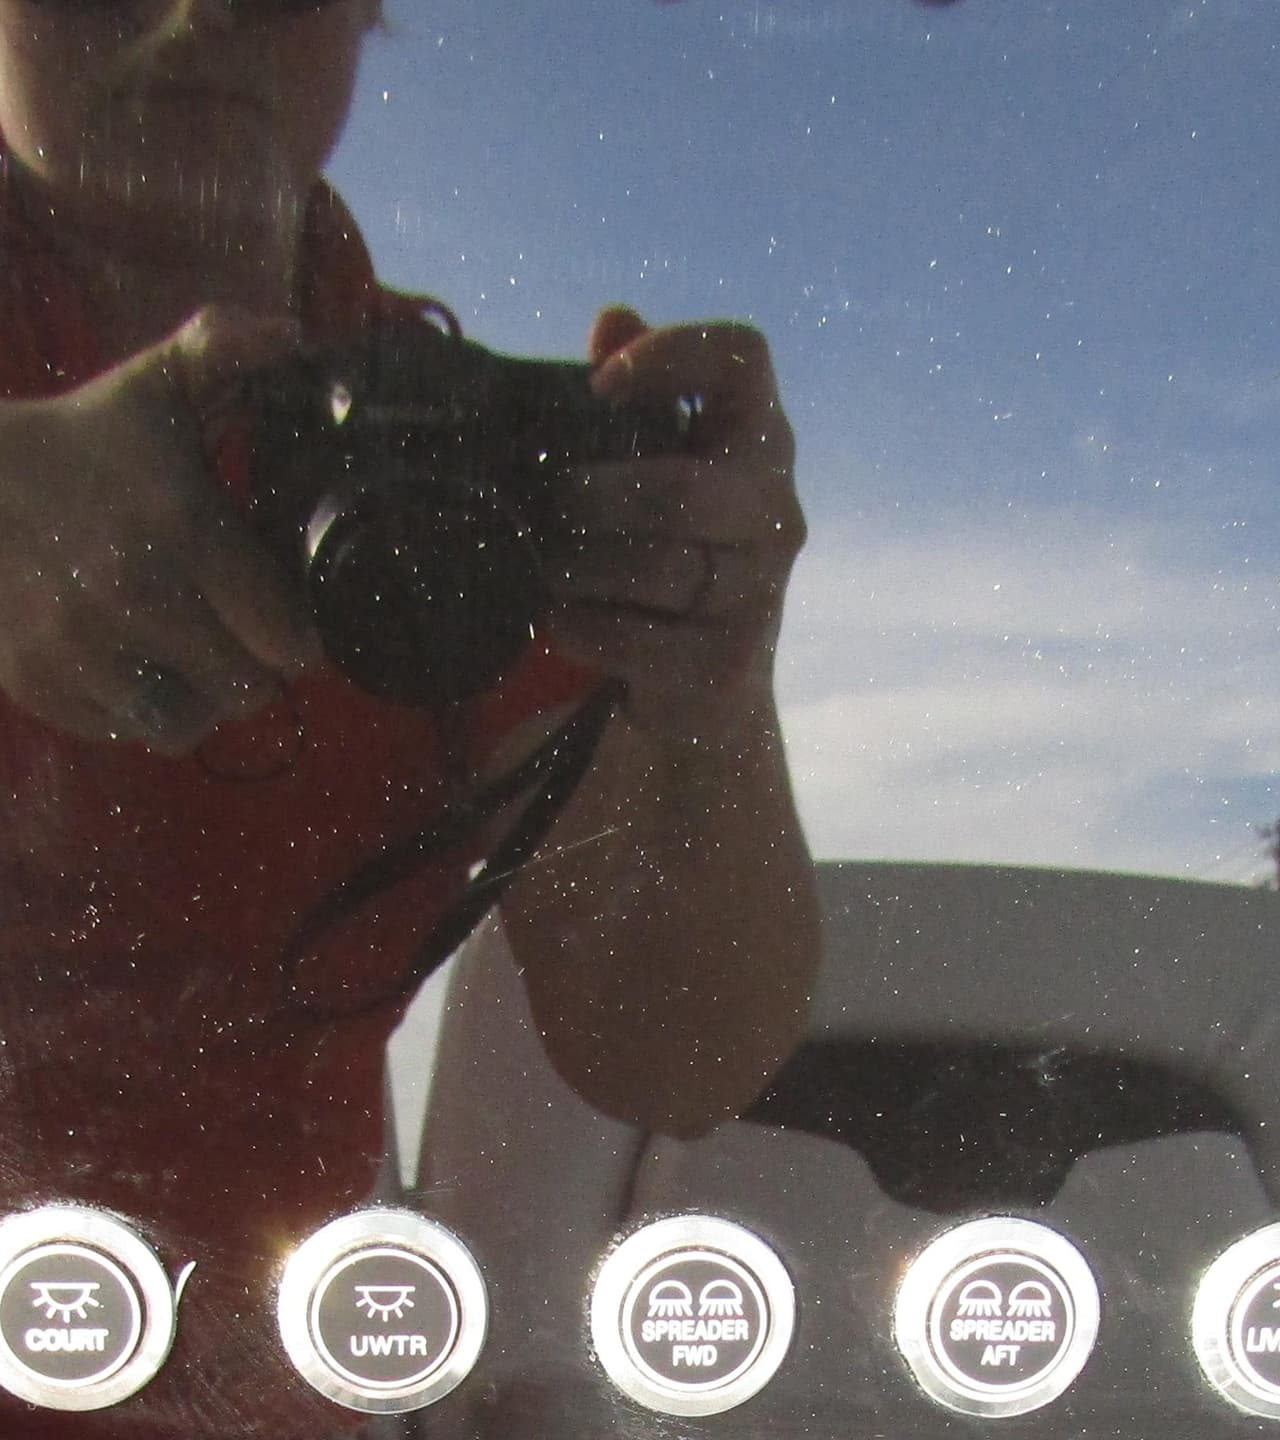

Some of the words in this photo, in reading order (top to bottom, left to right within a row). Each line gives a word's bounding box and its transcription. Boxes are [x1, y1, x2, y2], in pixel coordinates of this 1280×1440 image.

[24, 1328, 109, 1352] COURT
[641, 1319, 750, 1342] SPREADER
[949, 1318, 1056, 1343] SPREADER
[350, 1335, 428, 1357] UWTR
[672, 1344, 718, 1367] FWD
[981, 1344, 1020, 1367] AFT
